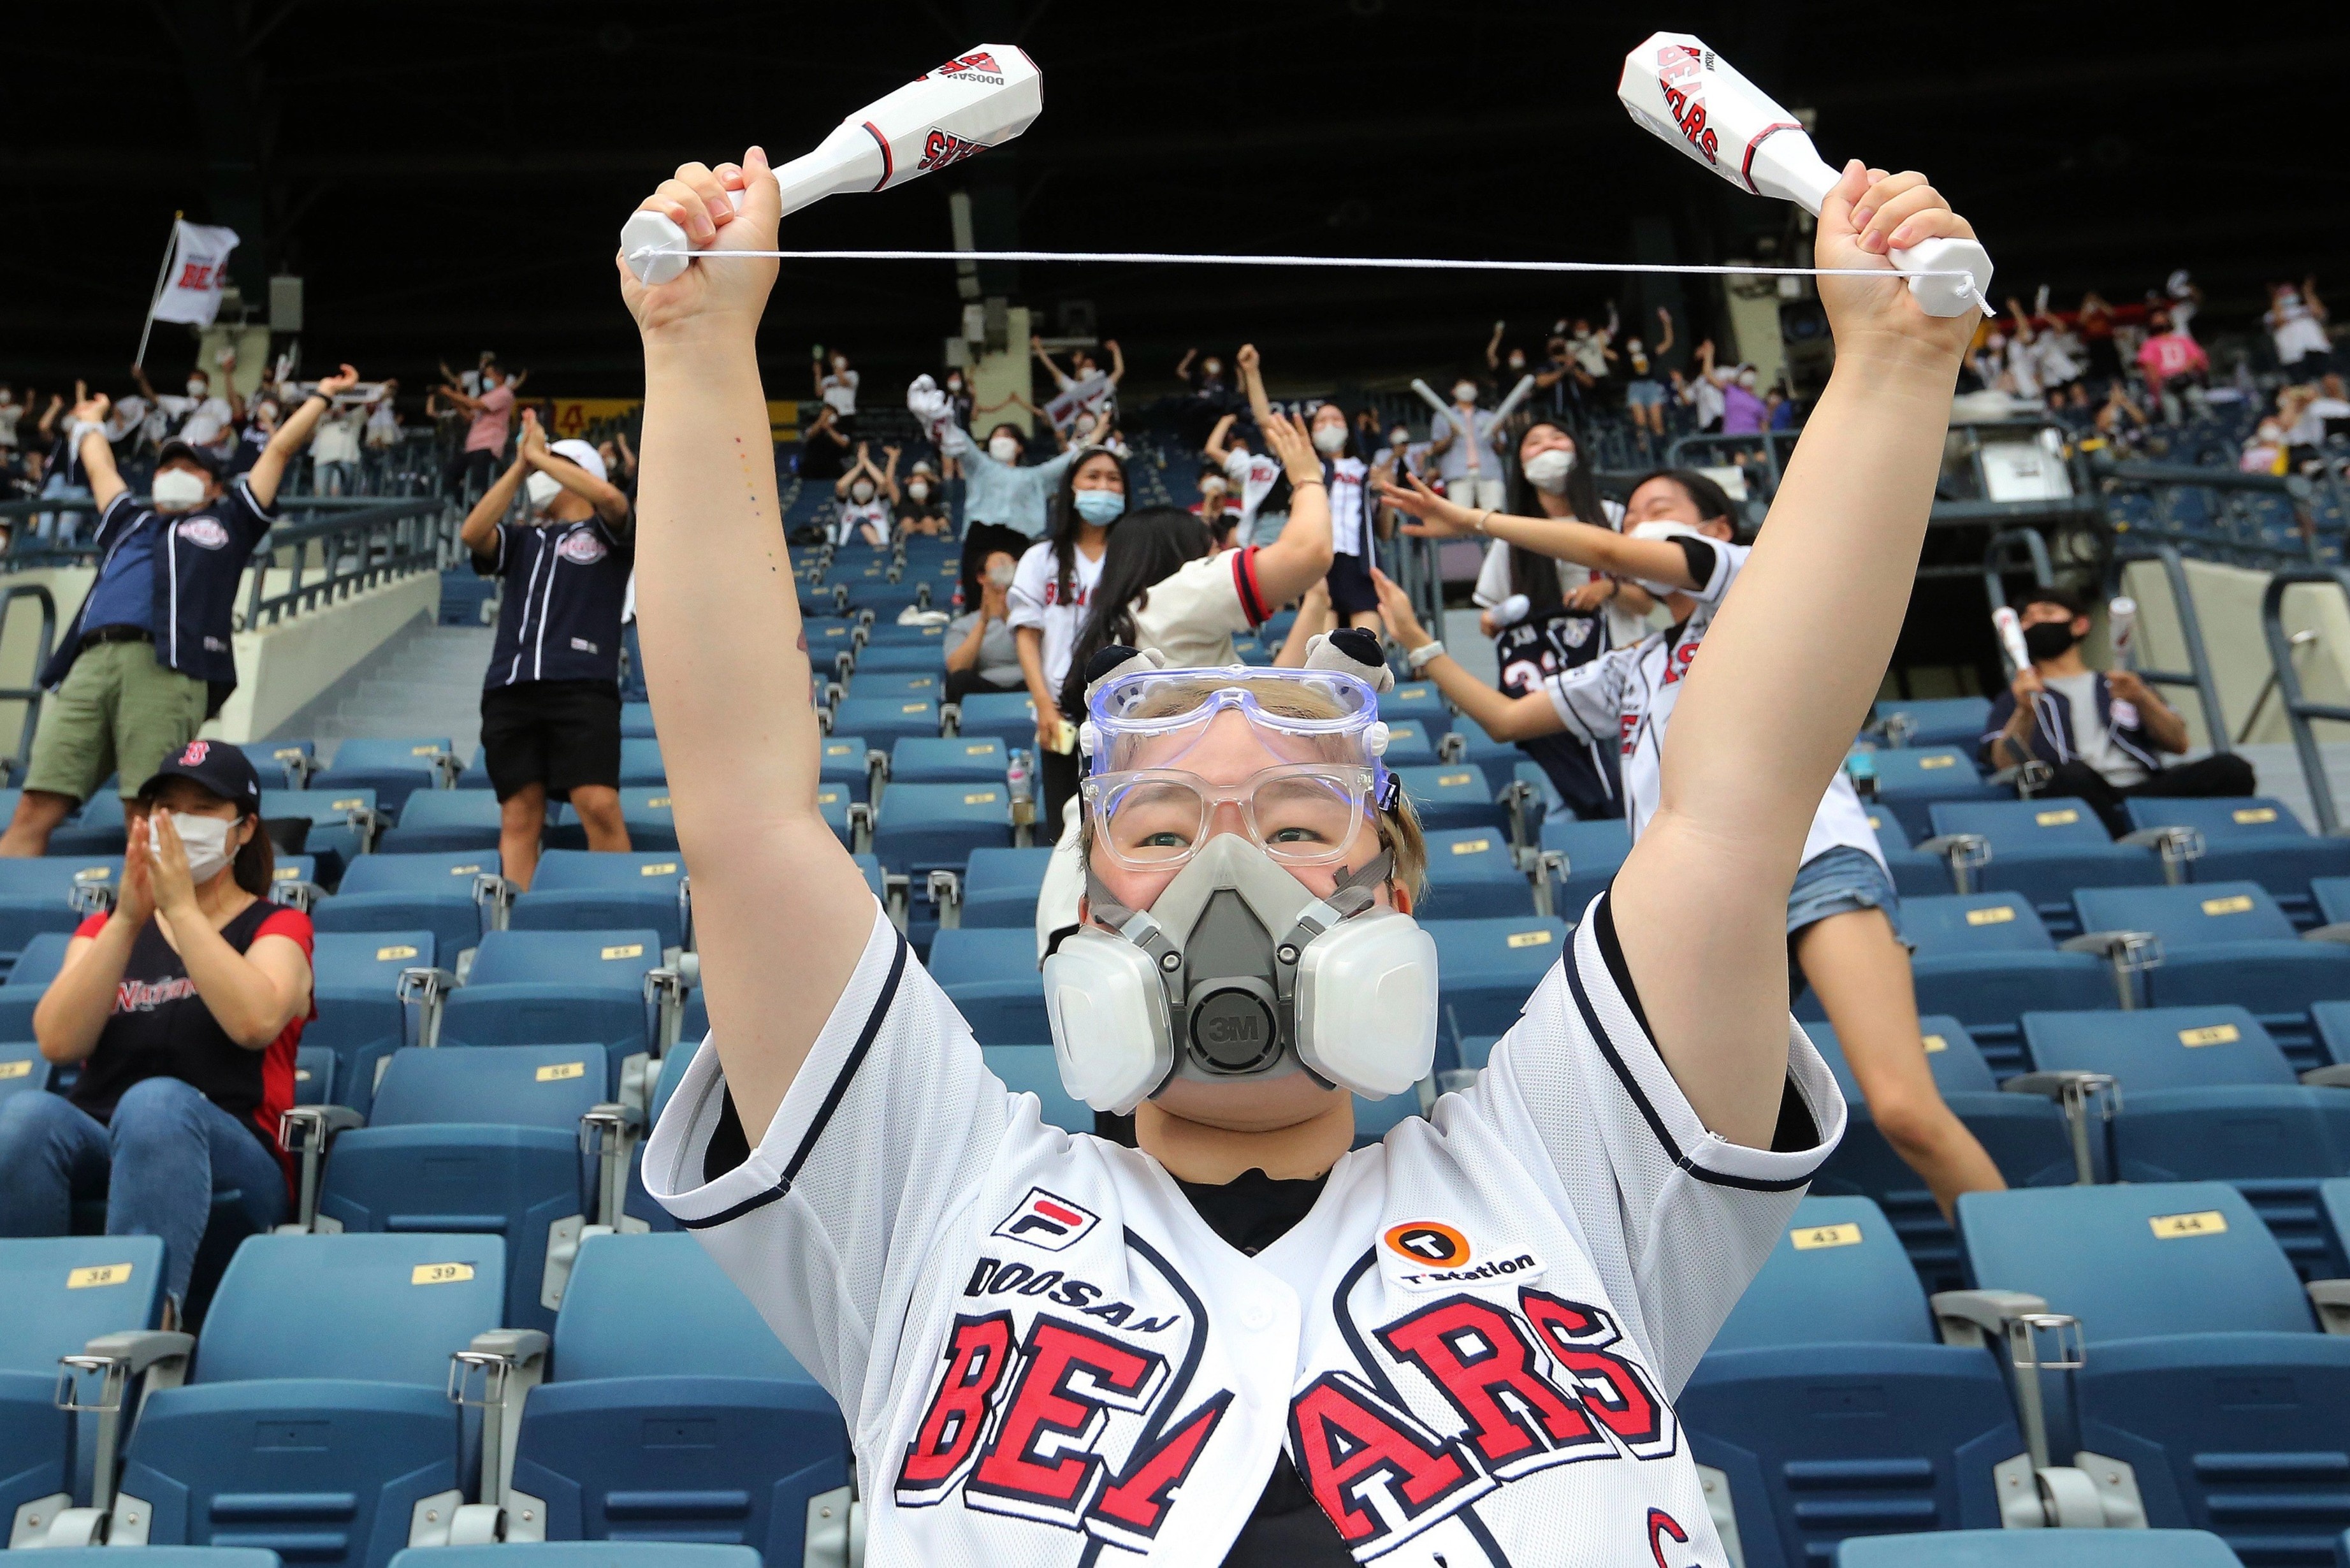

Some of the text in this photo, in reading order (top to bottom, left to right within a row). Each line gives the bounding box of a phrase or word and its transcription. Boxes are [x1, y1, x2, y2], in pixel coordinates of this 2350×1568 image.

[1208, 1015, 1259, 1043] 3M
[2173, 1217, 2201, 1230] 44
[1813, 1230, 1839, 1242] 43
[1404, 1233, 1445, 1259] T
[431, 1267, 456, 1280] 39
[964, 1258, 1181, 1333] DOOSAN
